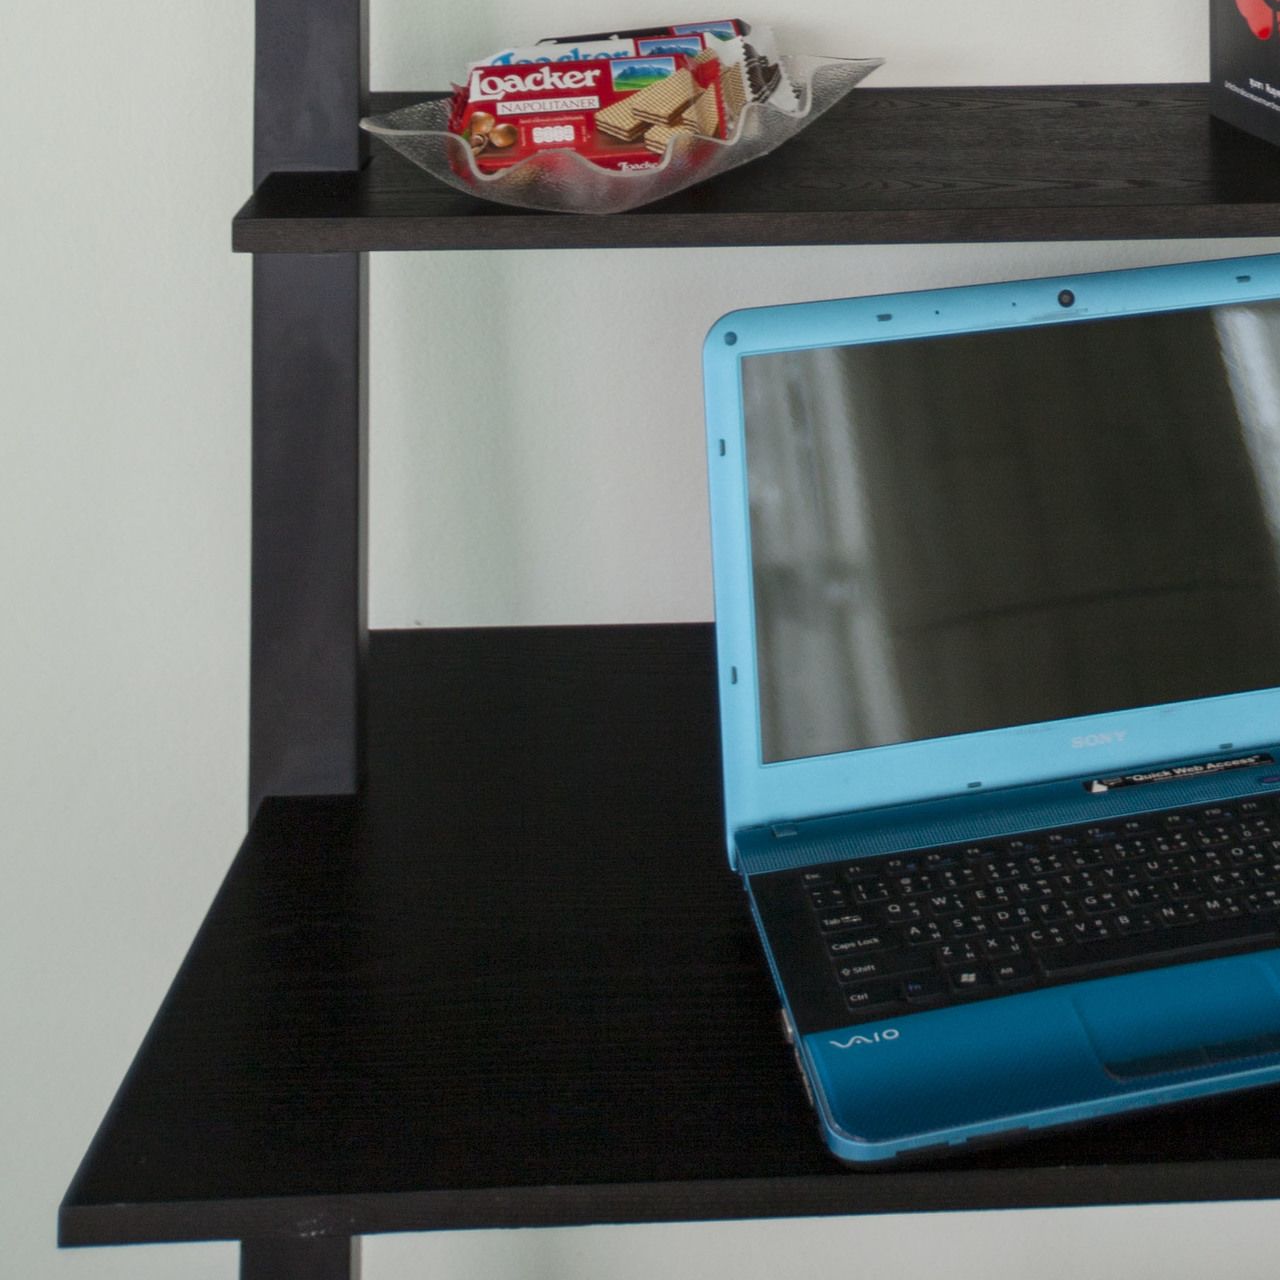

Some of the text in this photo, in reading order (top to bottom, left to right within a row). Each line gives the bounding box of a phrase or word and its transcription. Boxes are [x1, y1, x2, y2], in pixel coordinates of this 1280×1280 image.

[468, 66, 601, 102] Loacker
[501, 98, 597, 114] NAPOLITANER
[1072, 730, 1127, 749] SONY
[852, 964, 876, 974] Shift
[850, 992, 869, 1002] Ctrl
[830, 1029, 899, 1048] VAIO
